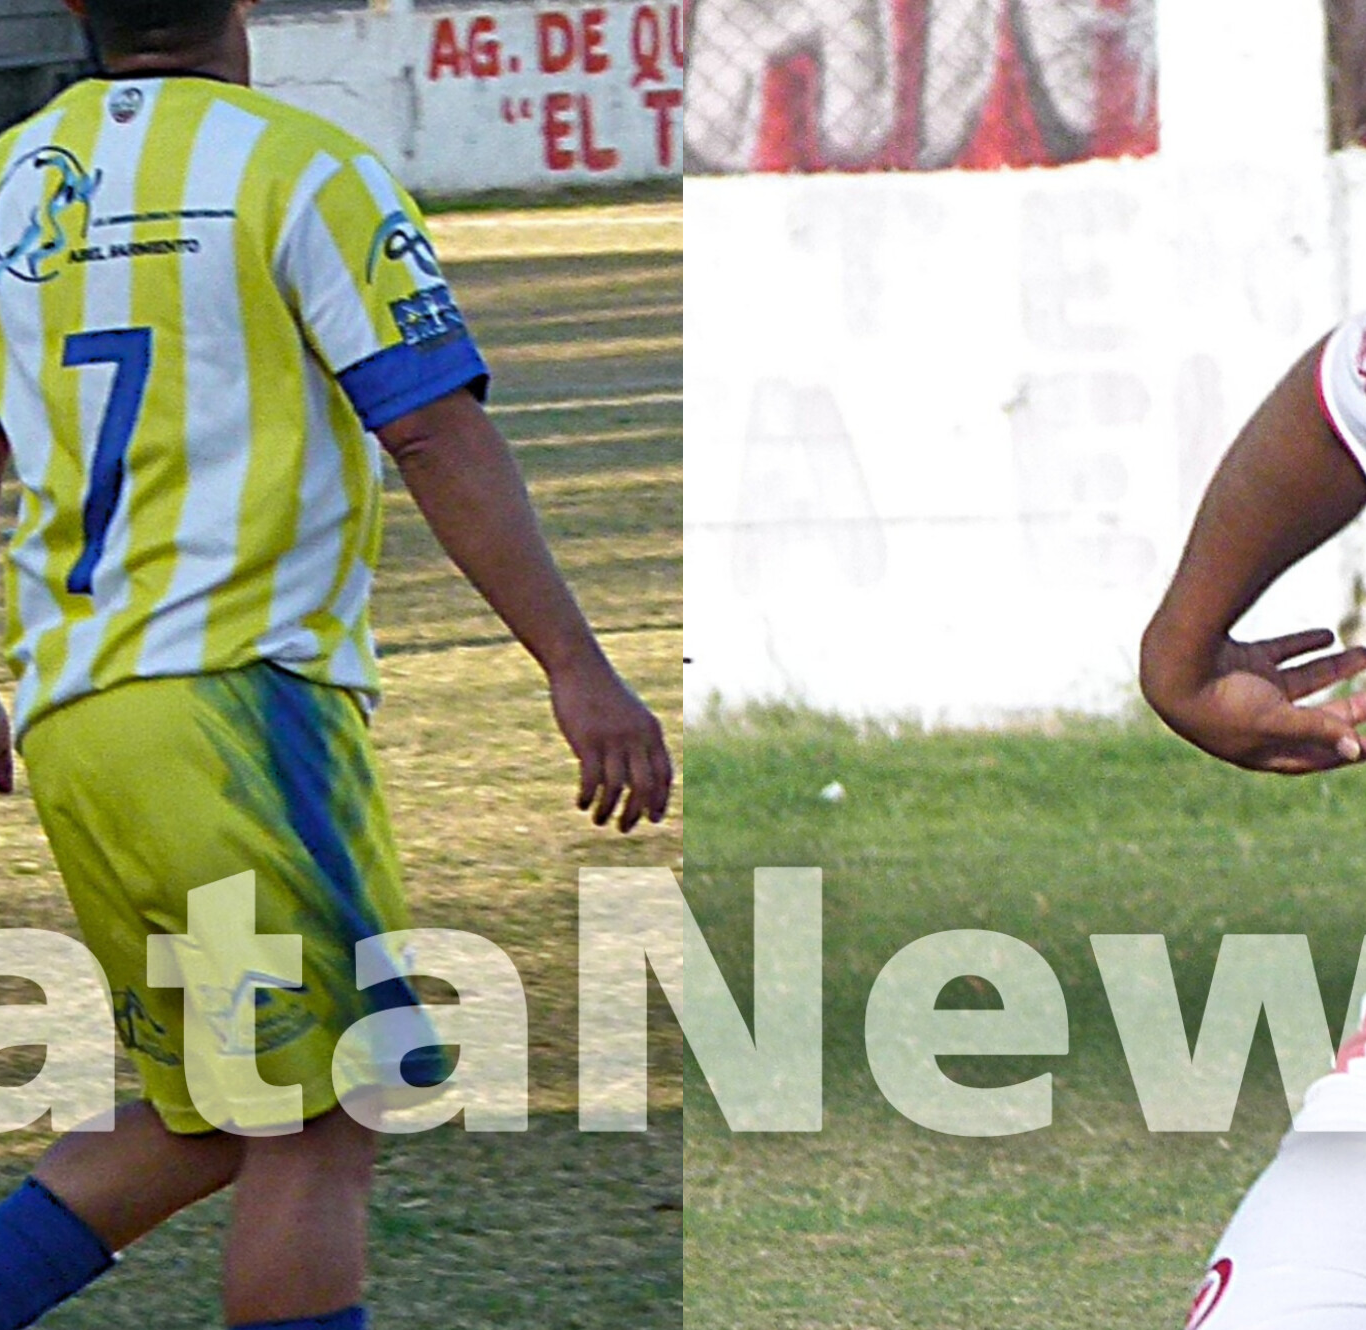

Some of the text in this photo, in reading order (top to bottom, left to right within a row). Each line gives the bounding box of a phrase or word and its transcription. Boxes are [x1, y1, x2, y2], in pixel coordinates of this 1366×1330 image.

[428, 16, 521, 81] AG.
[536, 10, 610, 75] DE
[62, 326, 152, 595] 7
